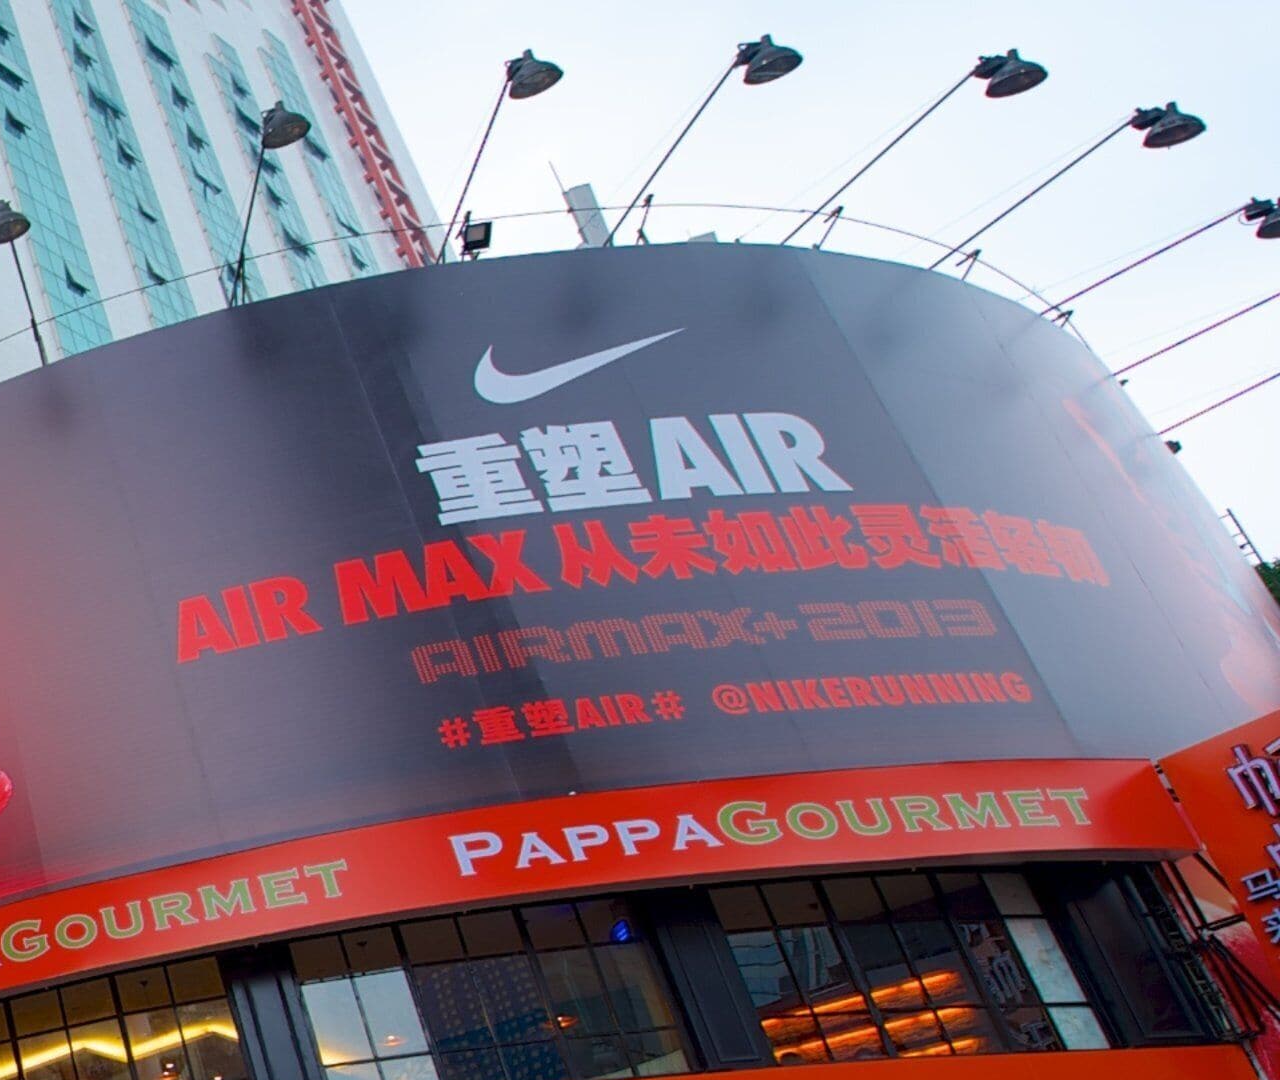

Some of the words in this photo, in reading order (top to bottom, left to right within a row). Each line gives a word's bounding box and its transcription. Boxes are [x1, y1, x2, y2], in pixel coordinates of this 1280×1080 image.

[415, 411, 853, 525] 重塑AIR
[177, 576, 323, 664] AIR
[334, 529, 552, 625] MAX
[712, 671, 1033, 715] @NIKERUNNING
